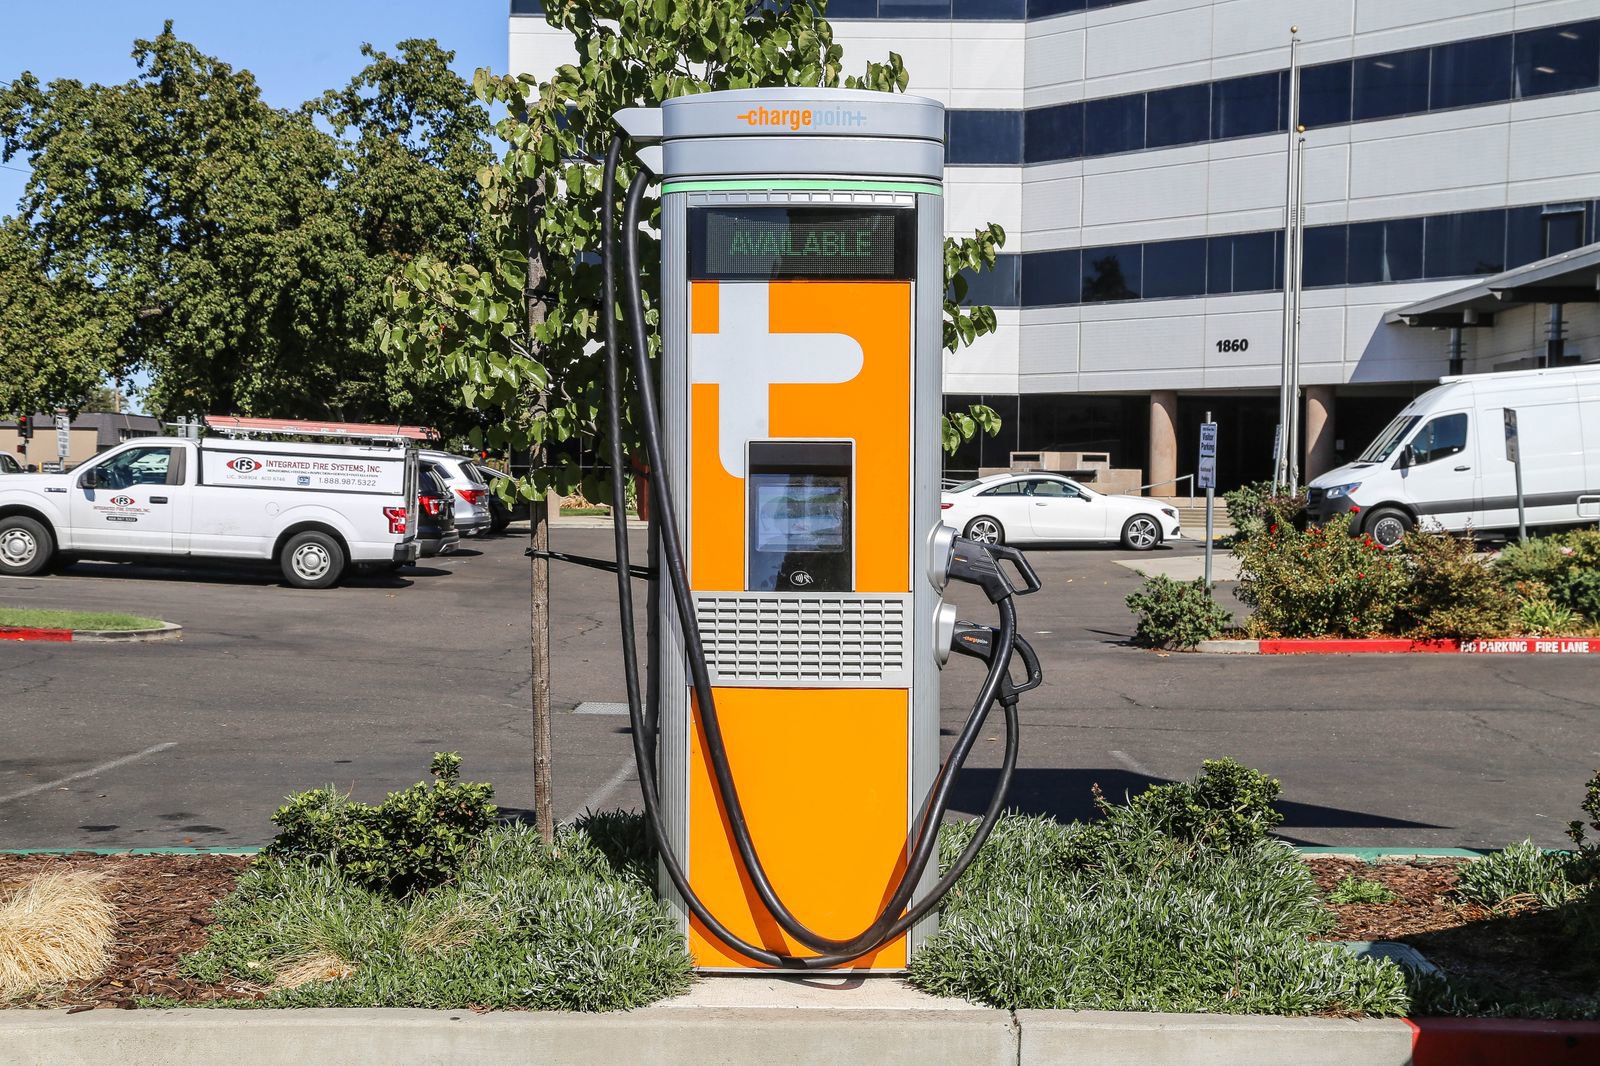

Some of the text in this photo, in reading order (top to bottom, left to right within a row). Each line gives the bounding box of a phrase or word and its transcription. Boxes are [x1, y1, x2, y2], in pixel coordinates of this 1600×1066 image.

[730, 231, 871, 256] AVAILABLE
[1216, 339, 1249, 352] 1860
[1201, 442, 1214, 453] Parking
[235, 460, 253, 470] IFS
[266, 459, 382, 473] INTEGRATED FIRE SYSTEMS, INC.
[319, 477, 376, 487] 1.888.987.5322
[1480, 641, 1528, 653] PARKING
[1536, 641, 1559, 653] FIRE
[1562, 641, 1590, 653] LANE
